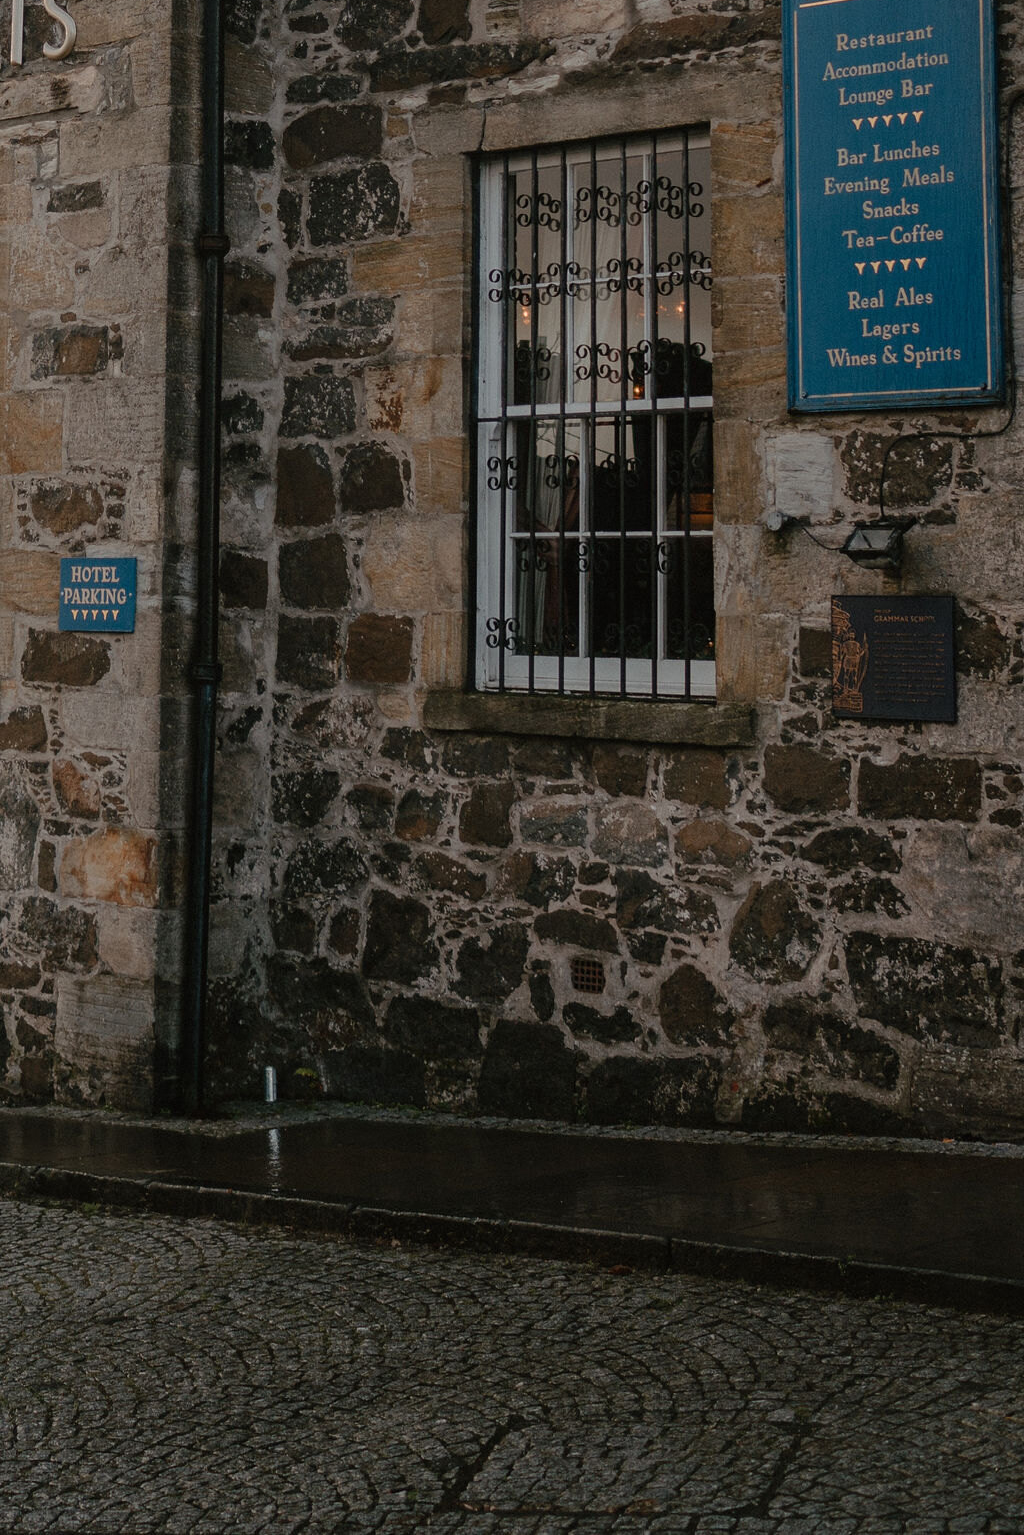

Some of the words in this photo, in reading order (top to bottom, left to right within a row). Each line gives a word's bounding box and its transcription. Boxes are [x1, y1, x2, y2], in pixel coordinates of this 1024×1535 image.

[836, 25, 934, 51] Restaurant
[822, 52, 949, 81] Accommodation
[838, 87, 894, 106] Lounge
[901, 79, 934, 98] Bar
[836, 148, 867, 167] Bar
[873, 140, 940, 163] Lunches
[824, 176, 890, 195] Evening
[902, 165, 955, 187] Meals
[862, 197, 920, 219] Snacks
[847, 289, 884, 310] Real
[895, 286, 934, 306] Ales
[861, 318, 920, 340] Lagers
[826, 348, 877, 367] Wines
[882, 345, 898, 364] &
[903, 344, 961, 369] Spirits
[71, 566, 120, 583] HOTEL
[63, 587, 127, 605] PARKING
